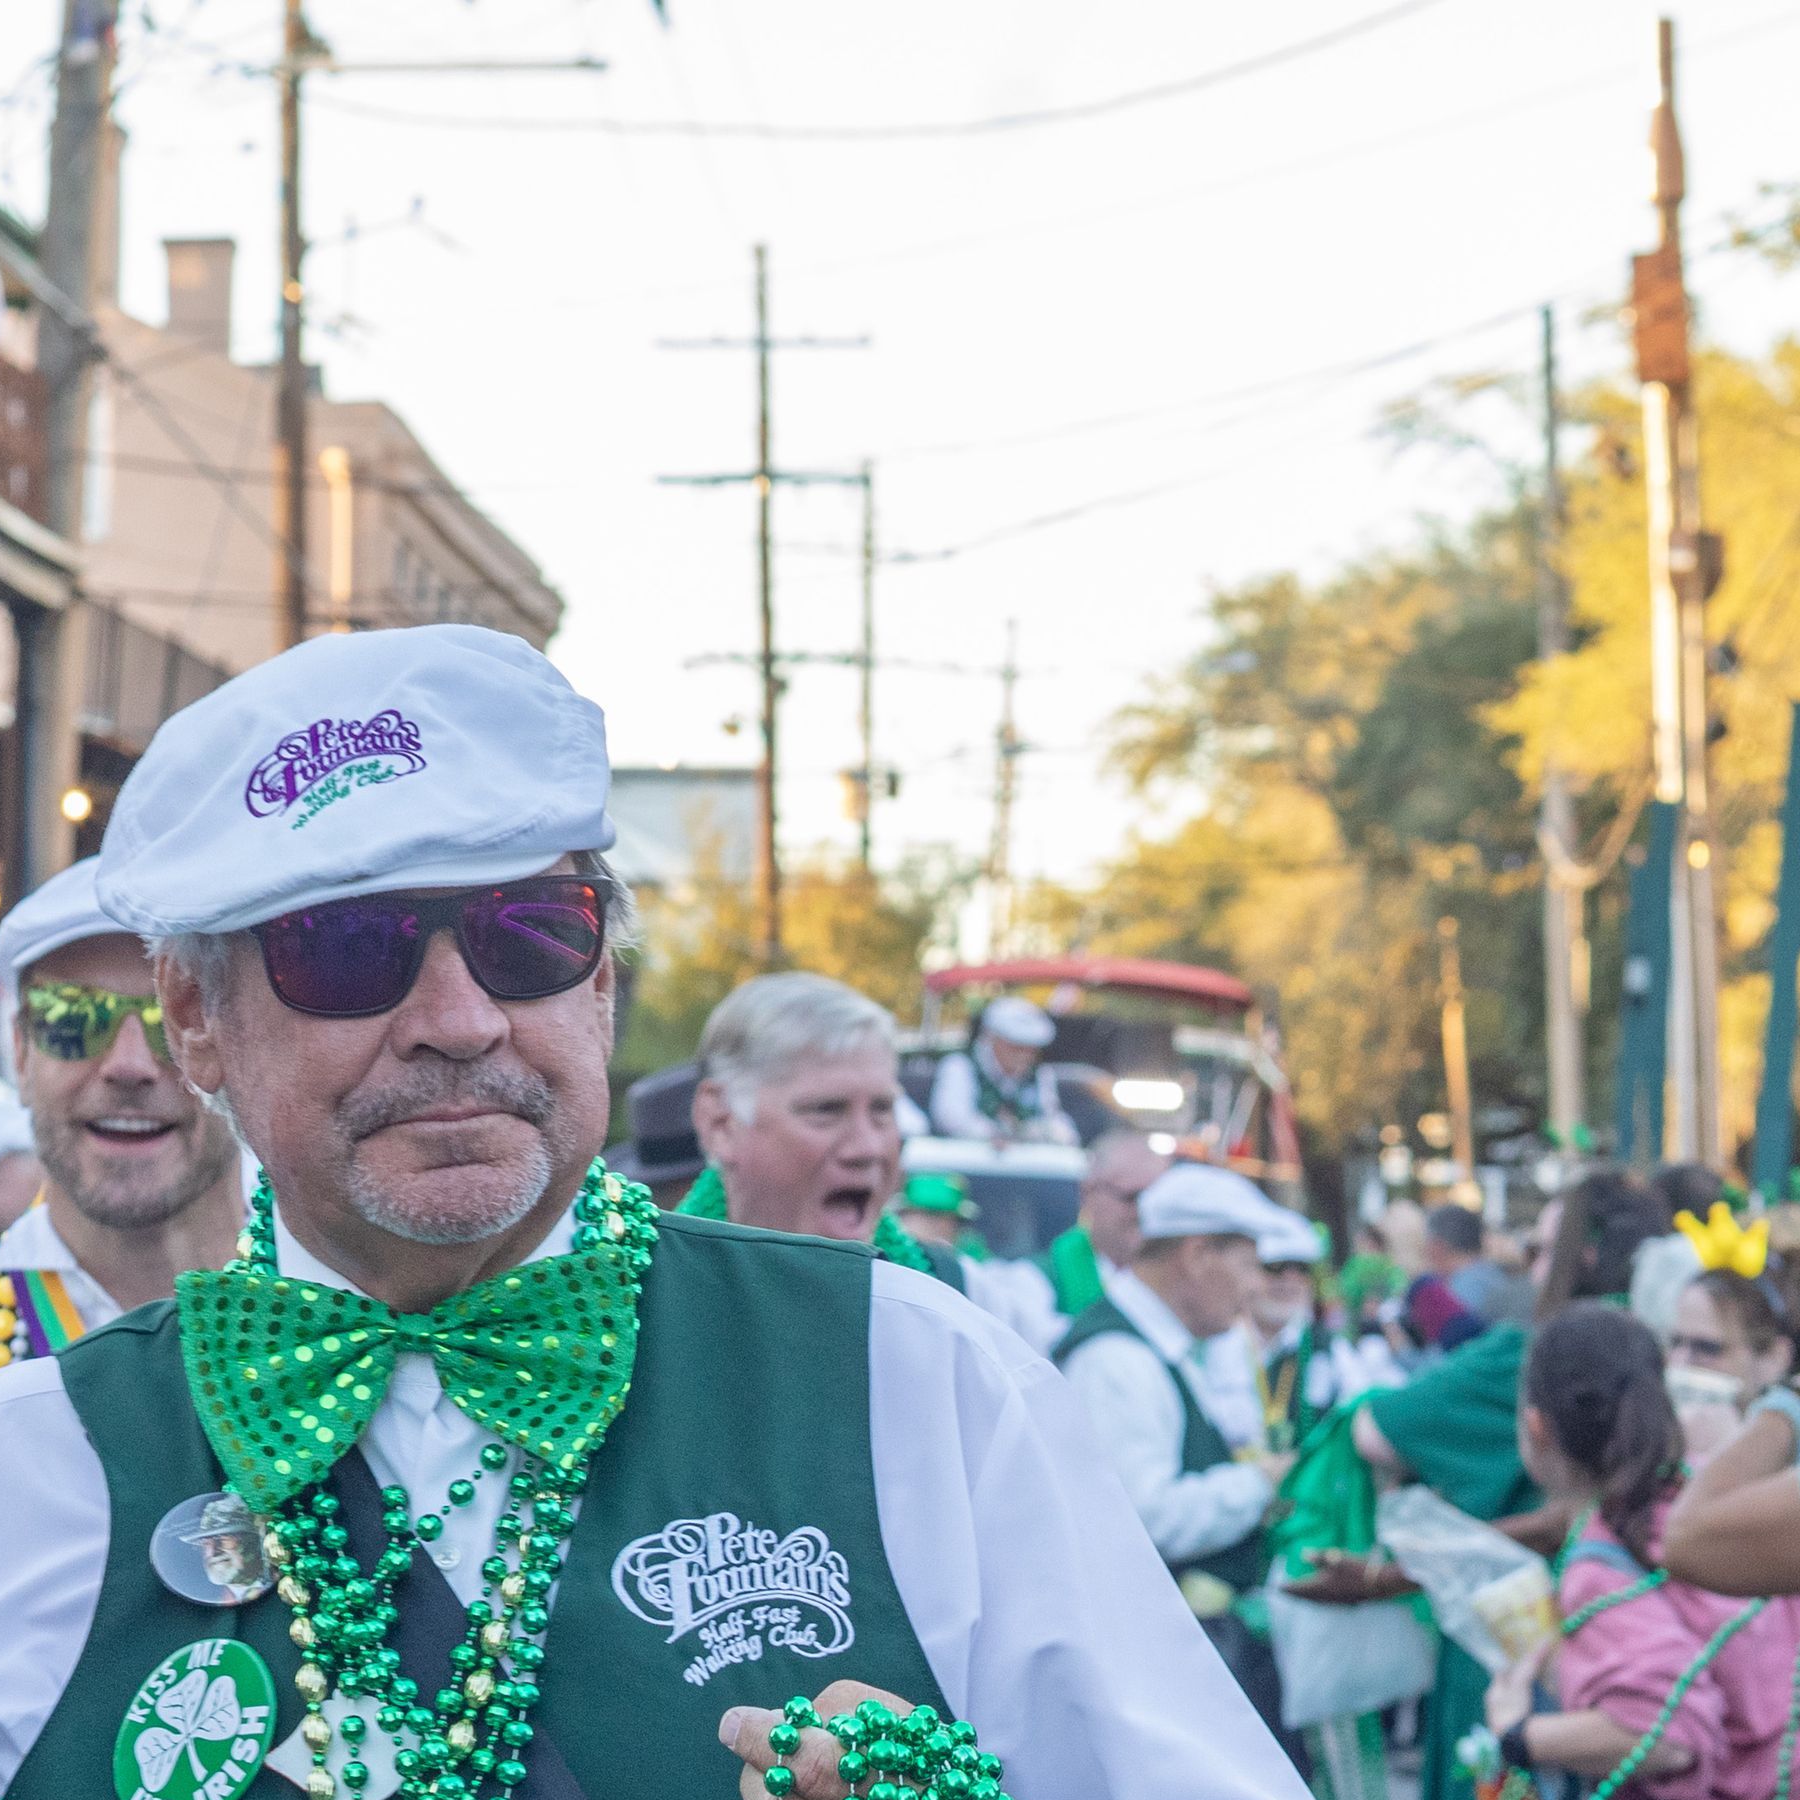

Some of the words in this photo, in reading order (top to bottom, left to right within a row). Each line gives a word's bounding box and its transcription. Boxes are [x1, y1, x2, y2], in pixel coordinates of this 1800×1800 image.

[284, 717, 363, 761] Pete
[674, 1512, 778, 1570] Pete
[683, 1634, 763, 1687] Walking
[768, 1623, 818, 1649] Club
[698, 1604, 802, 1649] Half-Fast
[126, 1661, 177, 1725] KISS
[186, 1638, 229, 1670] ME
